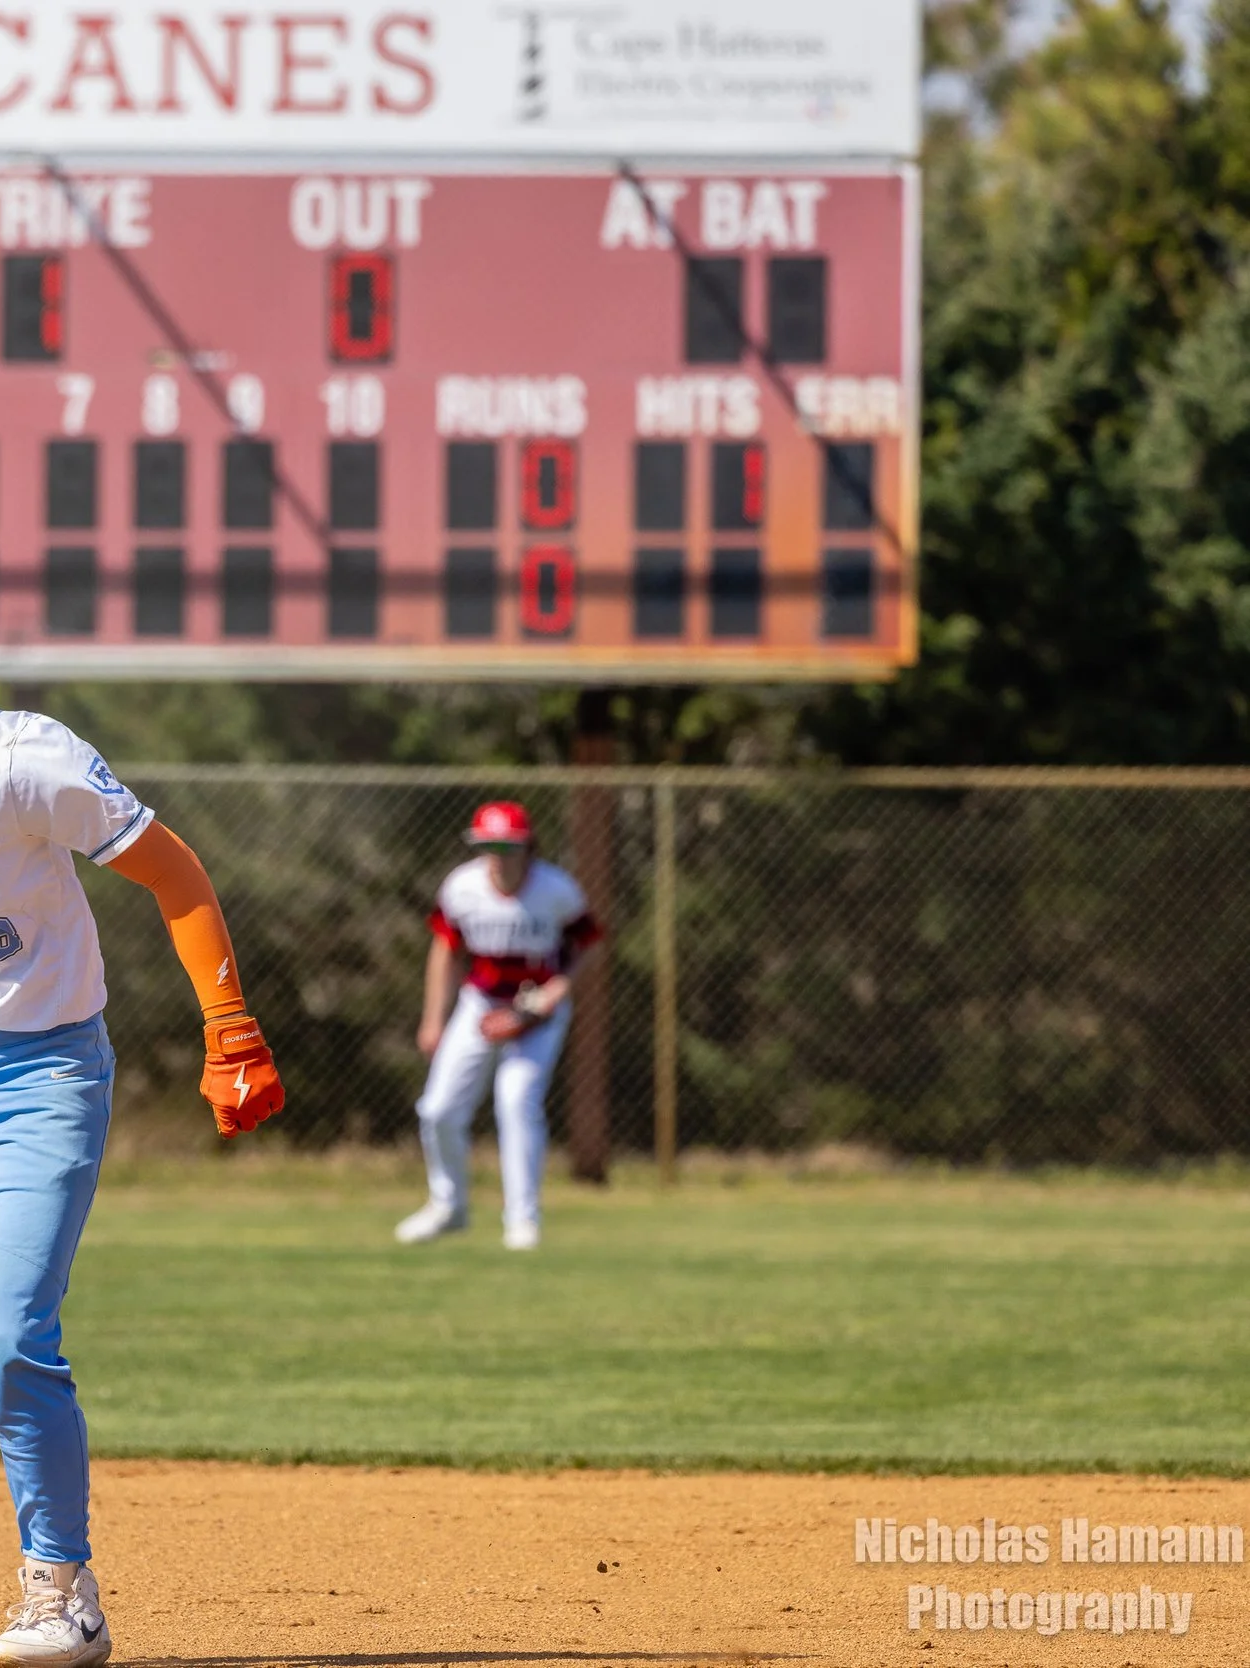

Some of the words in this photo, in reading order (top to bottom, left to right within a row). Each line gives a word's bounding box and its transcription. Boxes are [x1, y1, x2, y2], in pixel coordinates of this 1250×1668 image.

[291, 178, 430, 249] OUT
[602, 181, 686, 247] AT
[702, 181, 824, 248] BAT
[330, 252, 392, 357] 0
[57, 373, 94, 432] 7
[142, 374, 179, 434] 8
[228, 374, 265, 433] 9
[321, 375, 386, 435] 10
[436, 375, 587, 436] RUNS
[636, 376, 760, 436] HITS
[521, 440, 575, 527] 0
[521, 543, 575, 632] 0
